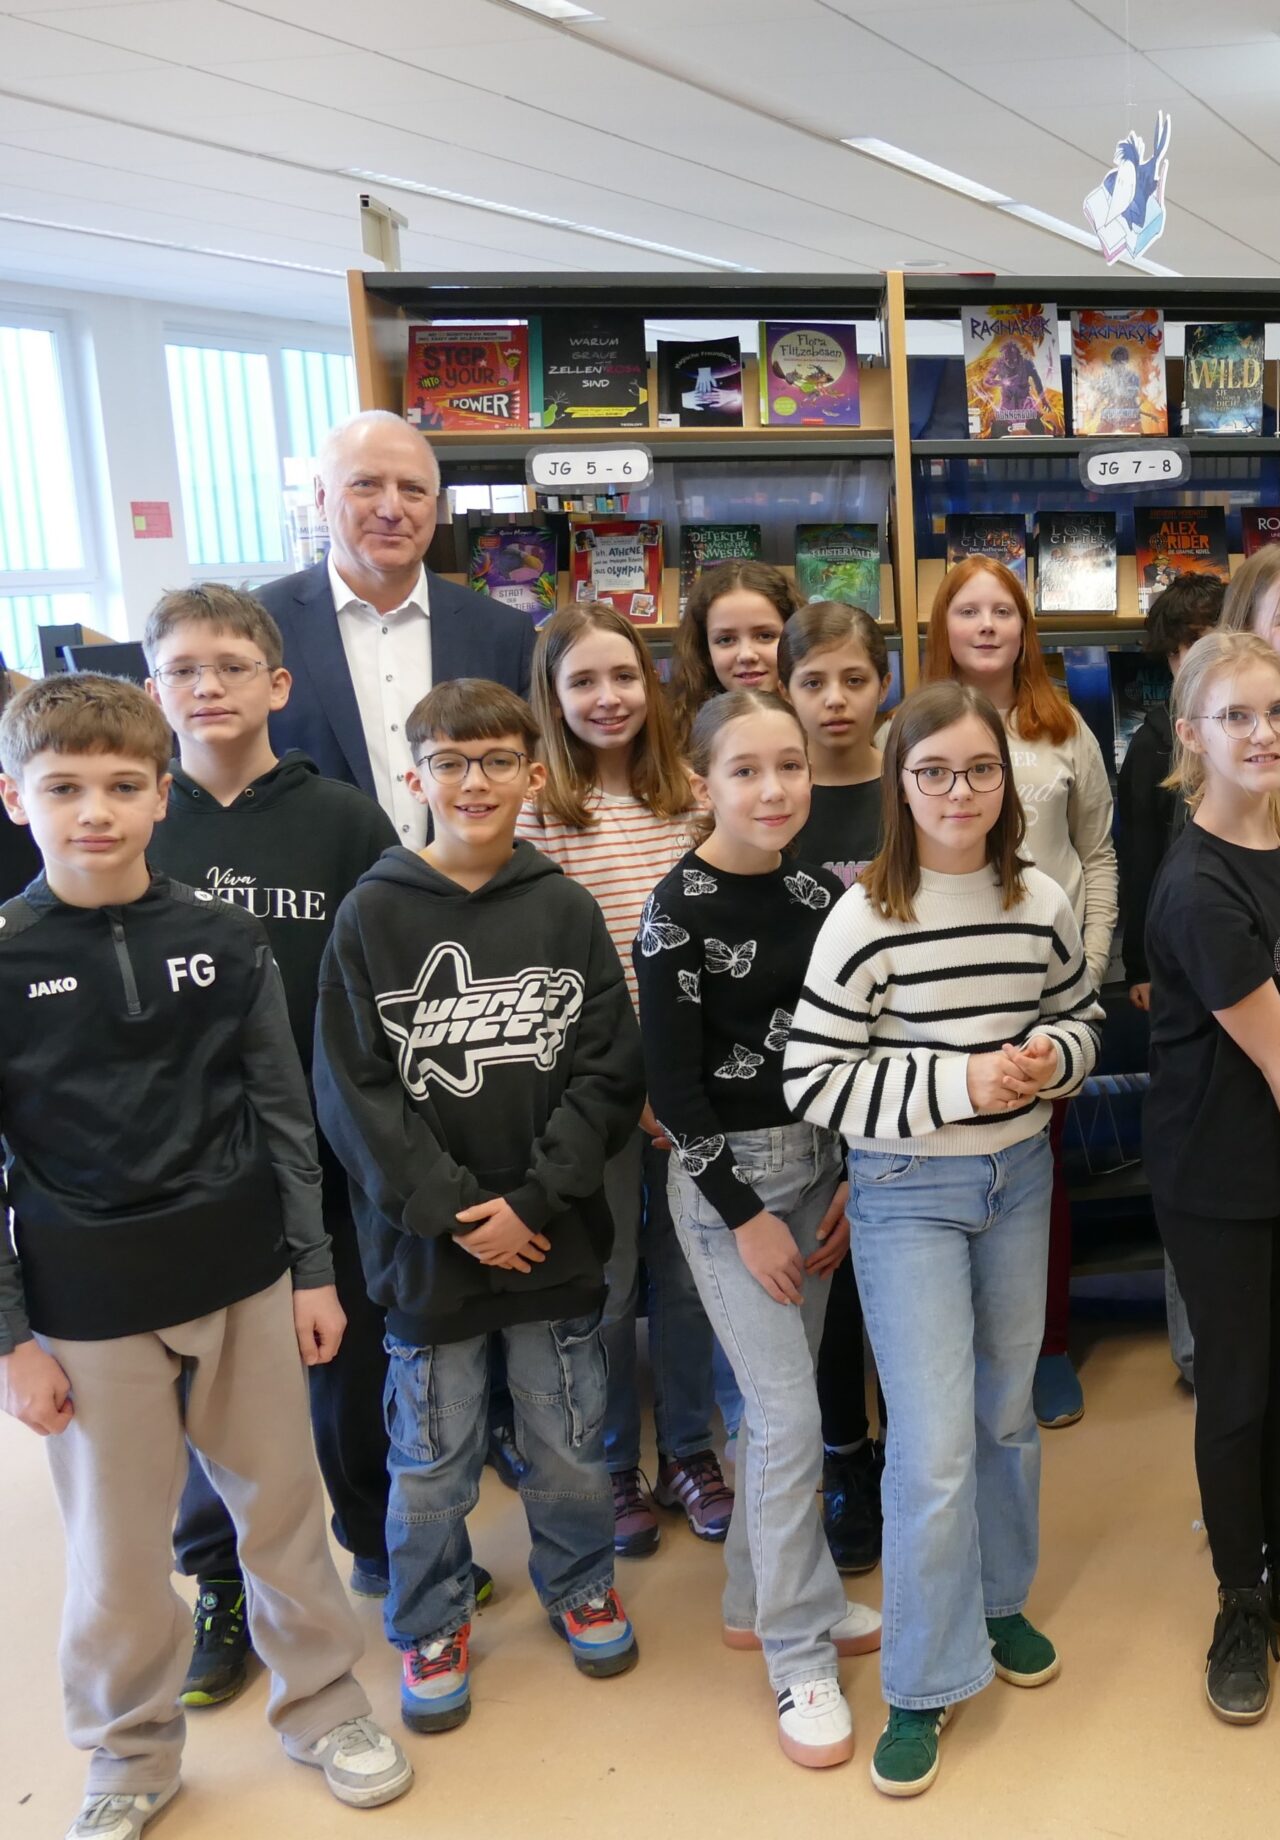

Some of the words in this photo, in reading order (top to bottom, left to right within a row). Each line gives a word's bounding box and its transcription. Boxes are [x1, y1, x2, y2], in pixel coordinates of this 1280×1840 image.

[569, 338, 619, 346] WARUM
[797, 334, 826, 346] Flora
[571, 351, 617, 360] GRAUE
[780, 344, 842, 358] Flitzebesen
[548, 365, 602, 375] ZELLEN
[1189, 358, 1261, 389] WILD
[445, 367, 494, 388] YOUR
[582, 379, 610, 388] SIND
[452, 393, 510, 418] POWER
[549, 461, 572, 475] JG
[586, 461, 597, 475] 5
[622, 461, 632, 475] 6
[1098, 462, 1119, 476] JG
[1132, 460, 1142, 474] 7
[1162, 459, 1171, 473] 8
[962, 527, 1017, 539] LOST
[1051, 525, 1107, 537] LOST
[1160, 521, 1198, 534] ALEX
[690, 530, 748, 543] DETEKTEI
[960, 538, 1018, 547] CITIES
[1050, 535, 1106, 544] CITIES
[1167, 535, 1210, 548] RIDER
[607, 565, 645, 578] OLYMPIA
[498, 588, 524, 598] STADT
[1010, 751, 1037, 767] ER
[1017, 768, 1063, 802] nd
[206, 866, 257, 888] Viva
[196, 887, 326, 921] TURE
[167, 953, 216, 992] FG
[28, 976, 78, 999] JAKO
